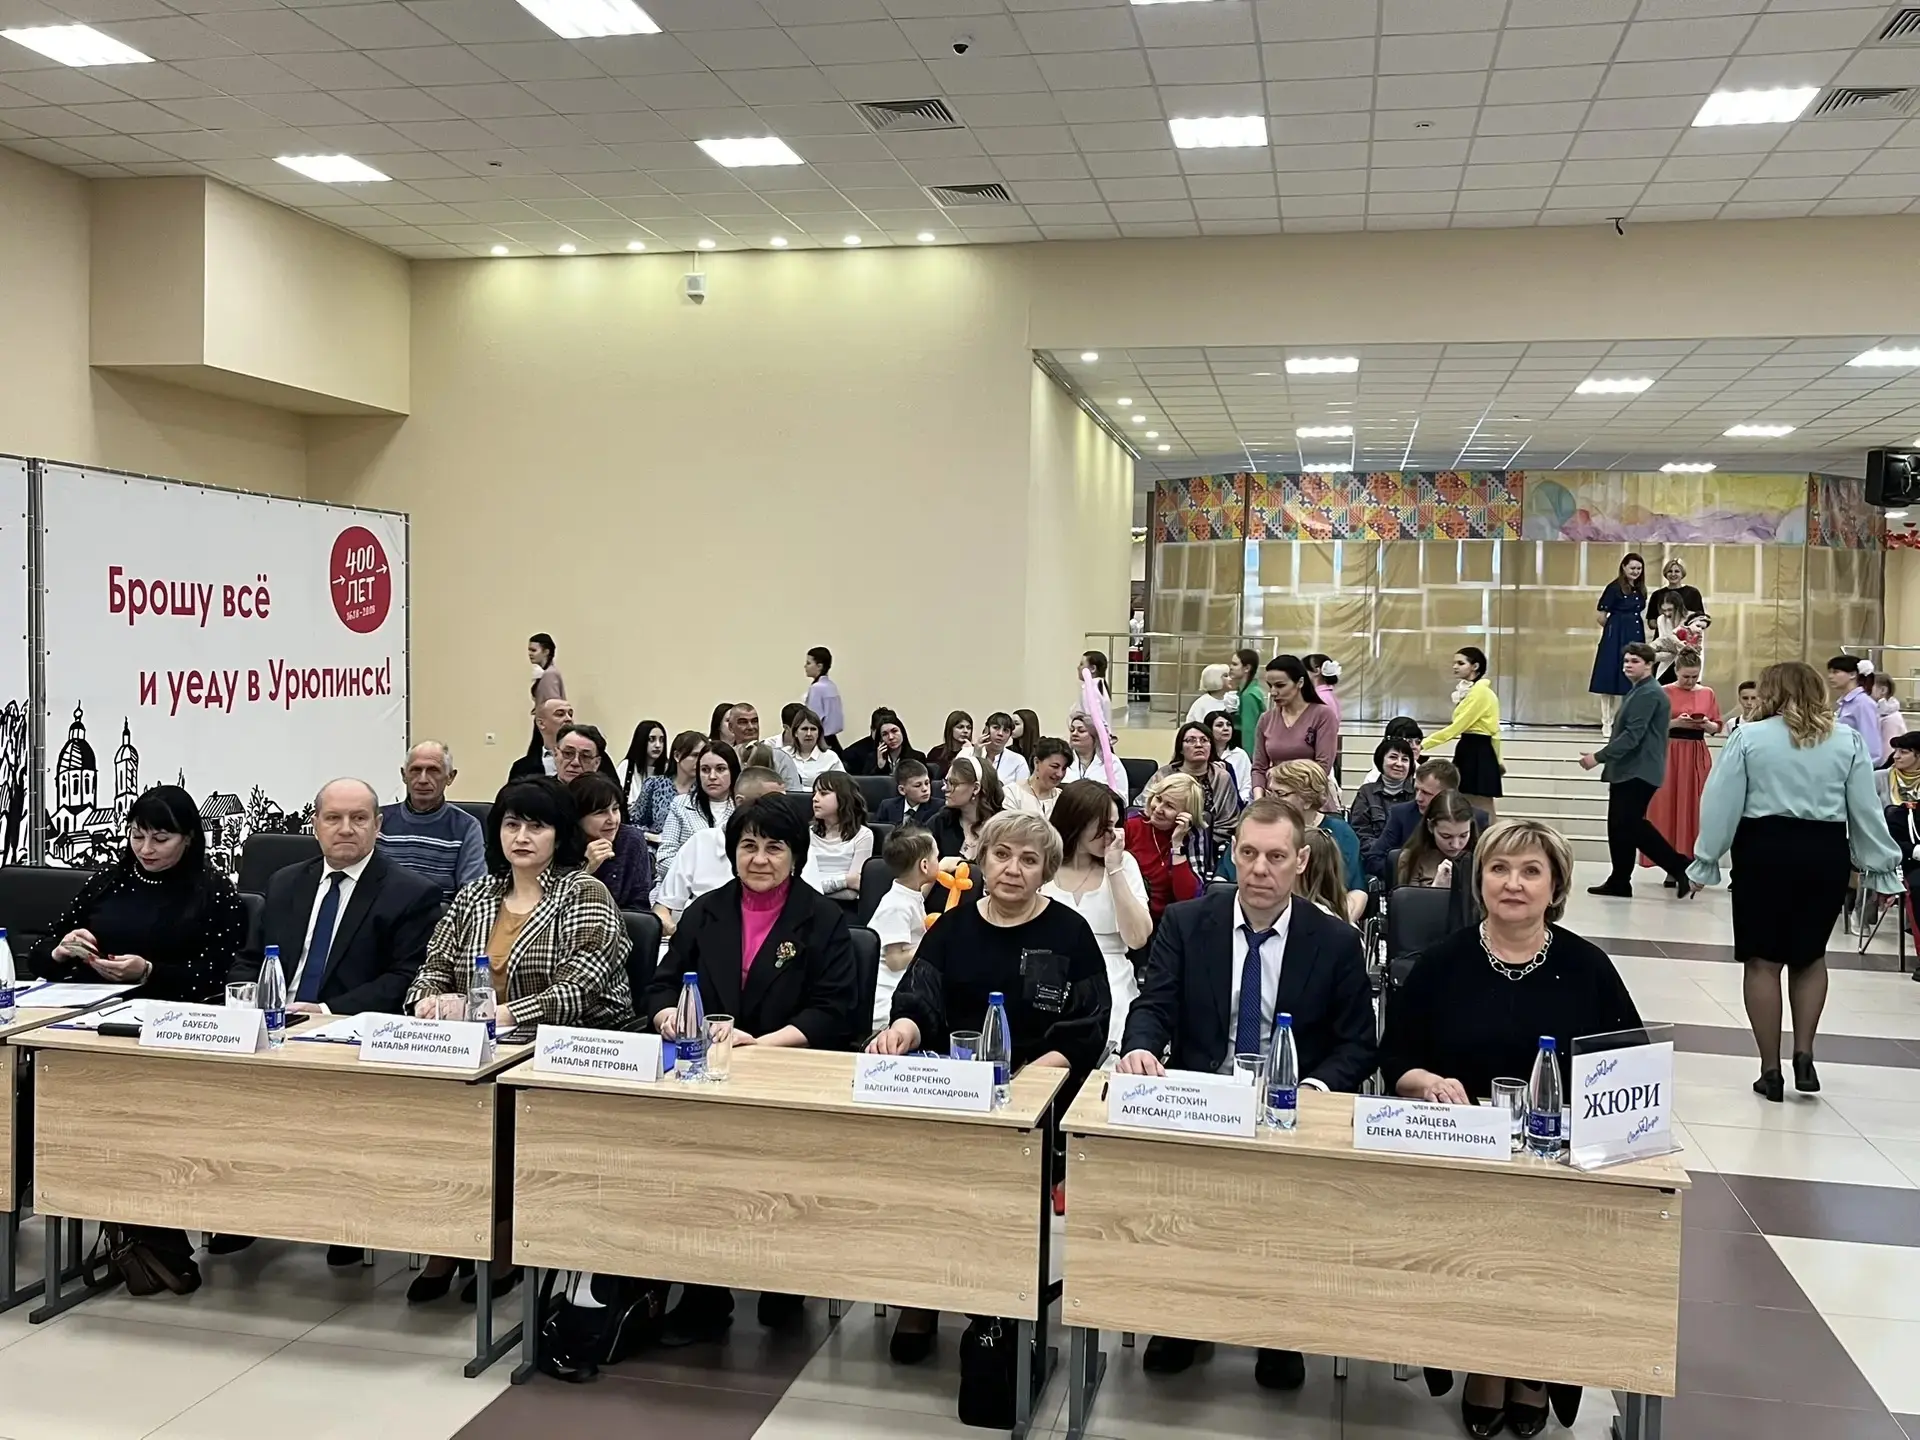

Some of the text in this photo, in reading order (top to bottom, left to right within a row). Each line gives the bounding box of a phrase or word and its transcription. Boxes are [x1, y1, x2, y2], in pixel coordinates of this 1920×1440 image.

[345, 544, 375, 576] 400
[109, 566, 271, 628] Брошу всё
[345, 576, 376, 606] ЛЕТ
[140, 656, 391, 717] и уеду в Урюпинск!
[182, 1020, 219, 1030] БАУБЕЛЬ
[156, 1030, 241, 1045] ИГОРЬ ВИКТОРОВИЧ
[393, 1030, 452, 1042] ЩЕРБАЧЕНКО
[371, 1041, 470, 1055] НАТАЛЬЯ НИКОЛАЕВНА
[572, 1045, 619, 1057] ЯКОВЕНКО
[551, 1056, 639, 1072] НАТАЛЬЯ ПЕТРОВНА
[894, 1073, 951, 1086] КОВЕРЧЕНКО
[864, 1083, 980, 1099] ВАЛЕНТИНА АЛЕКСАНДРОВНА
[1156, 1094, 1208, 1107] ФЕТЮХИН
[1583, 1082, 1661, 1119] ЖЮРИ
[1121, 1104, 1241, 1125] АЛЕКСАНДР ИВАНОВИЧ
[1405, 1114, 1457, 1129] ЗАЙЦЕВА
[1366, 1125, 1497, 1145] ЕЛЕНА ВАЛЕНТИНОВНА
